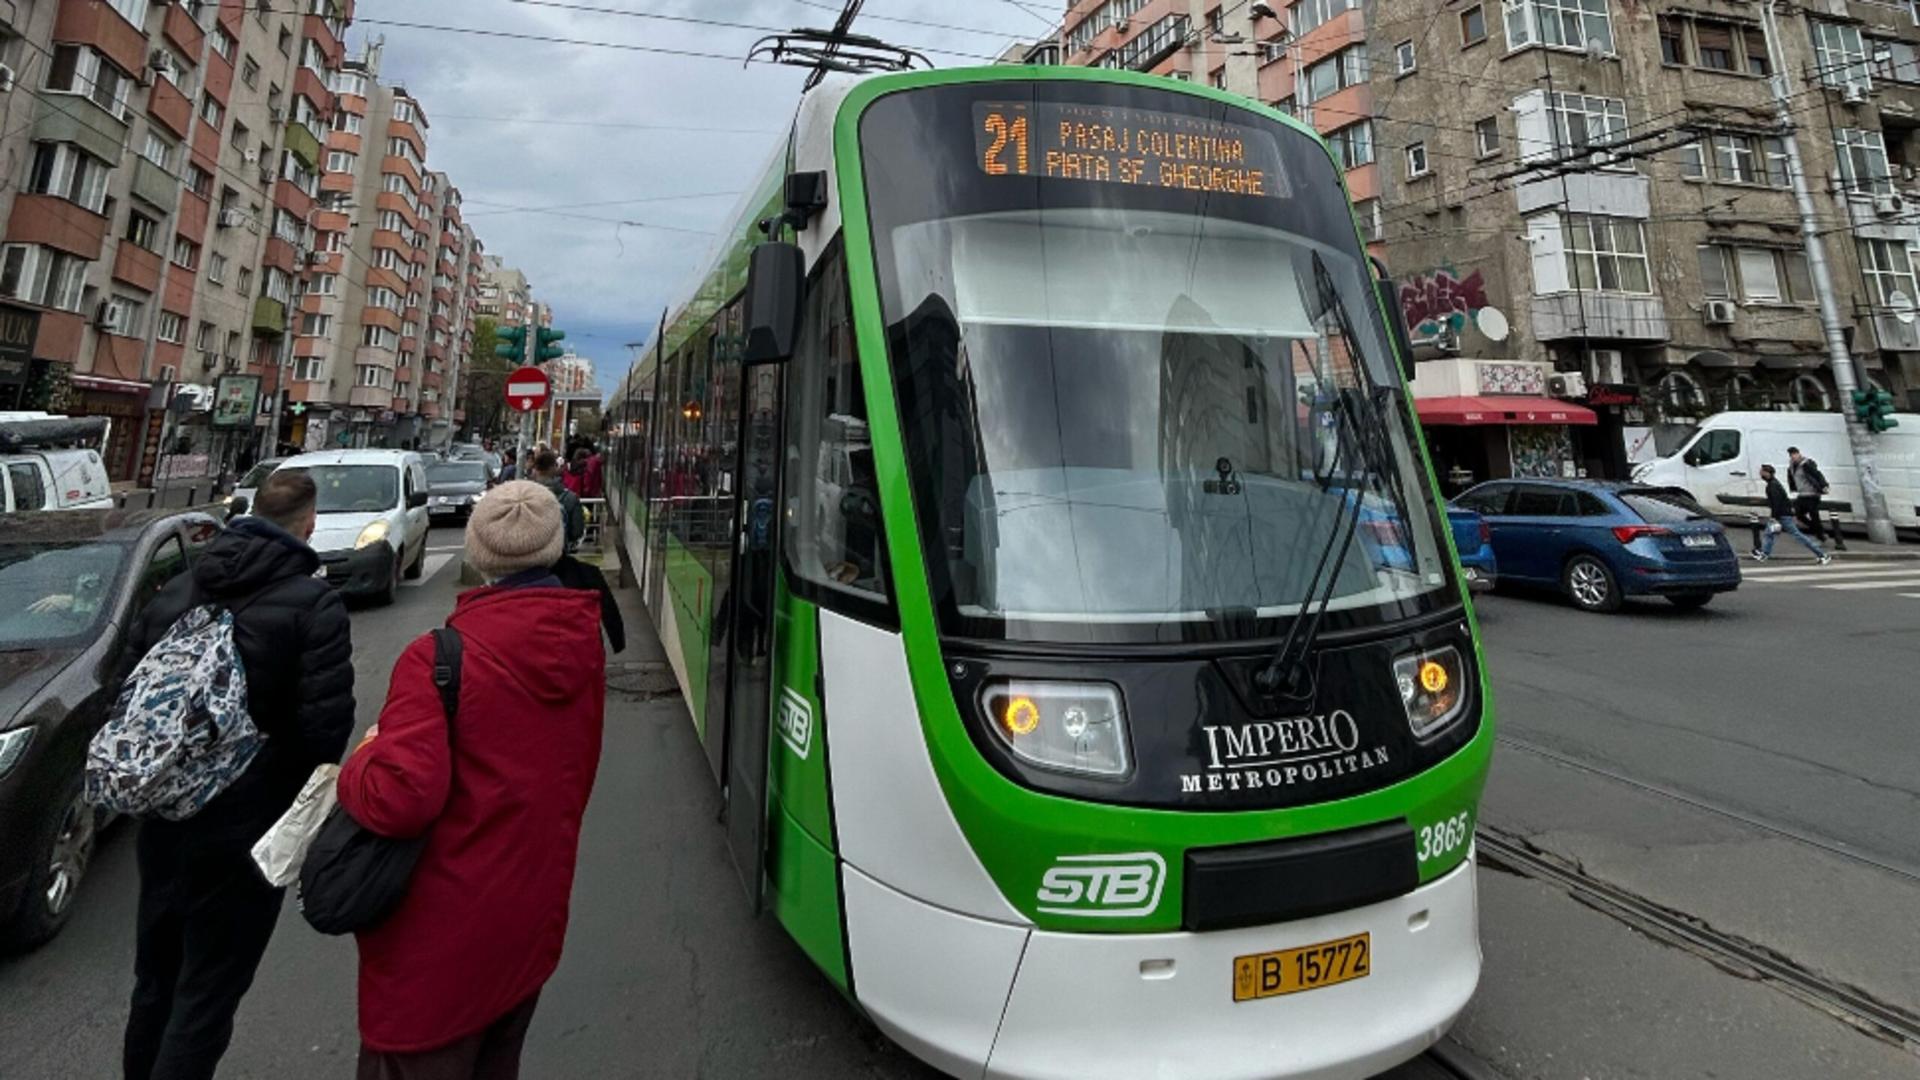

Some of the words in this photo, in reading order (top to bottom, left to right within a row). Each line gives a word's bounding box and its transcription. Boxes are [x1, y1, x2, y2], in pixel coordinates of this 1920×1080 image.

[984, 113, 1029, 176] 21
[1059, 120, 1129, 153] PASAJ
[1137, 129, 1243, 164] COLENTINA
[1046, 150, 1110, 182] PIATA
[1159, 161, 1265, 196] GHEORGHE
[777, 692, 808, 745] STB
[1203, 709, 1359, 768] IMPERIO
[1180, 746, 1390, 792] METROPOLITAN
[1417, 811, 1468, 862] 3865
[1036, 863, 1155, 905] STB
[1262, 957, 1281, 992] B
[1296, 939, 1367, 986] 15772
